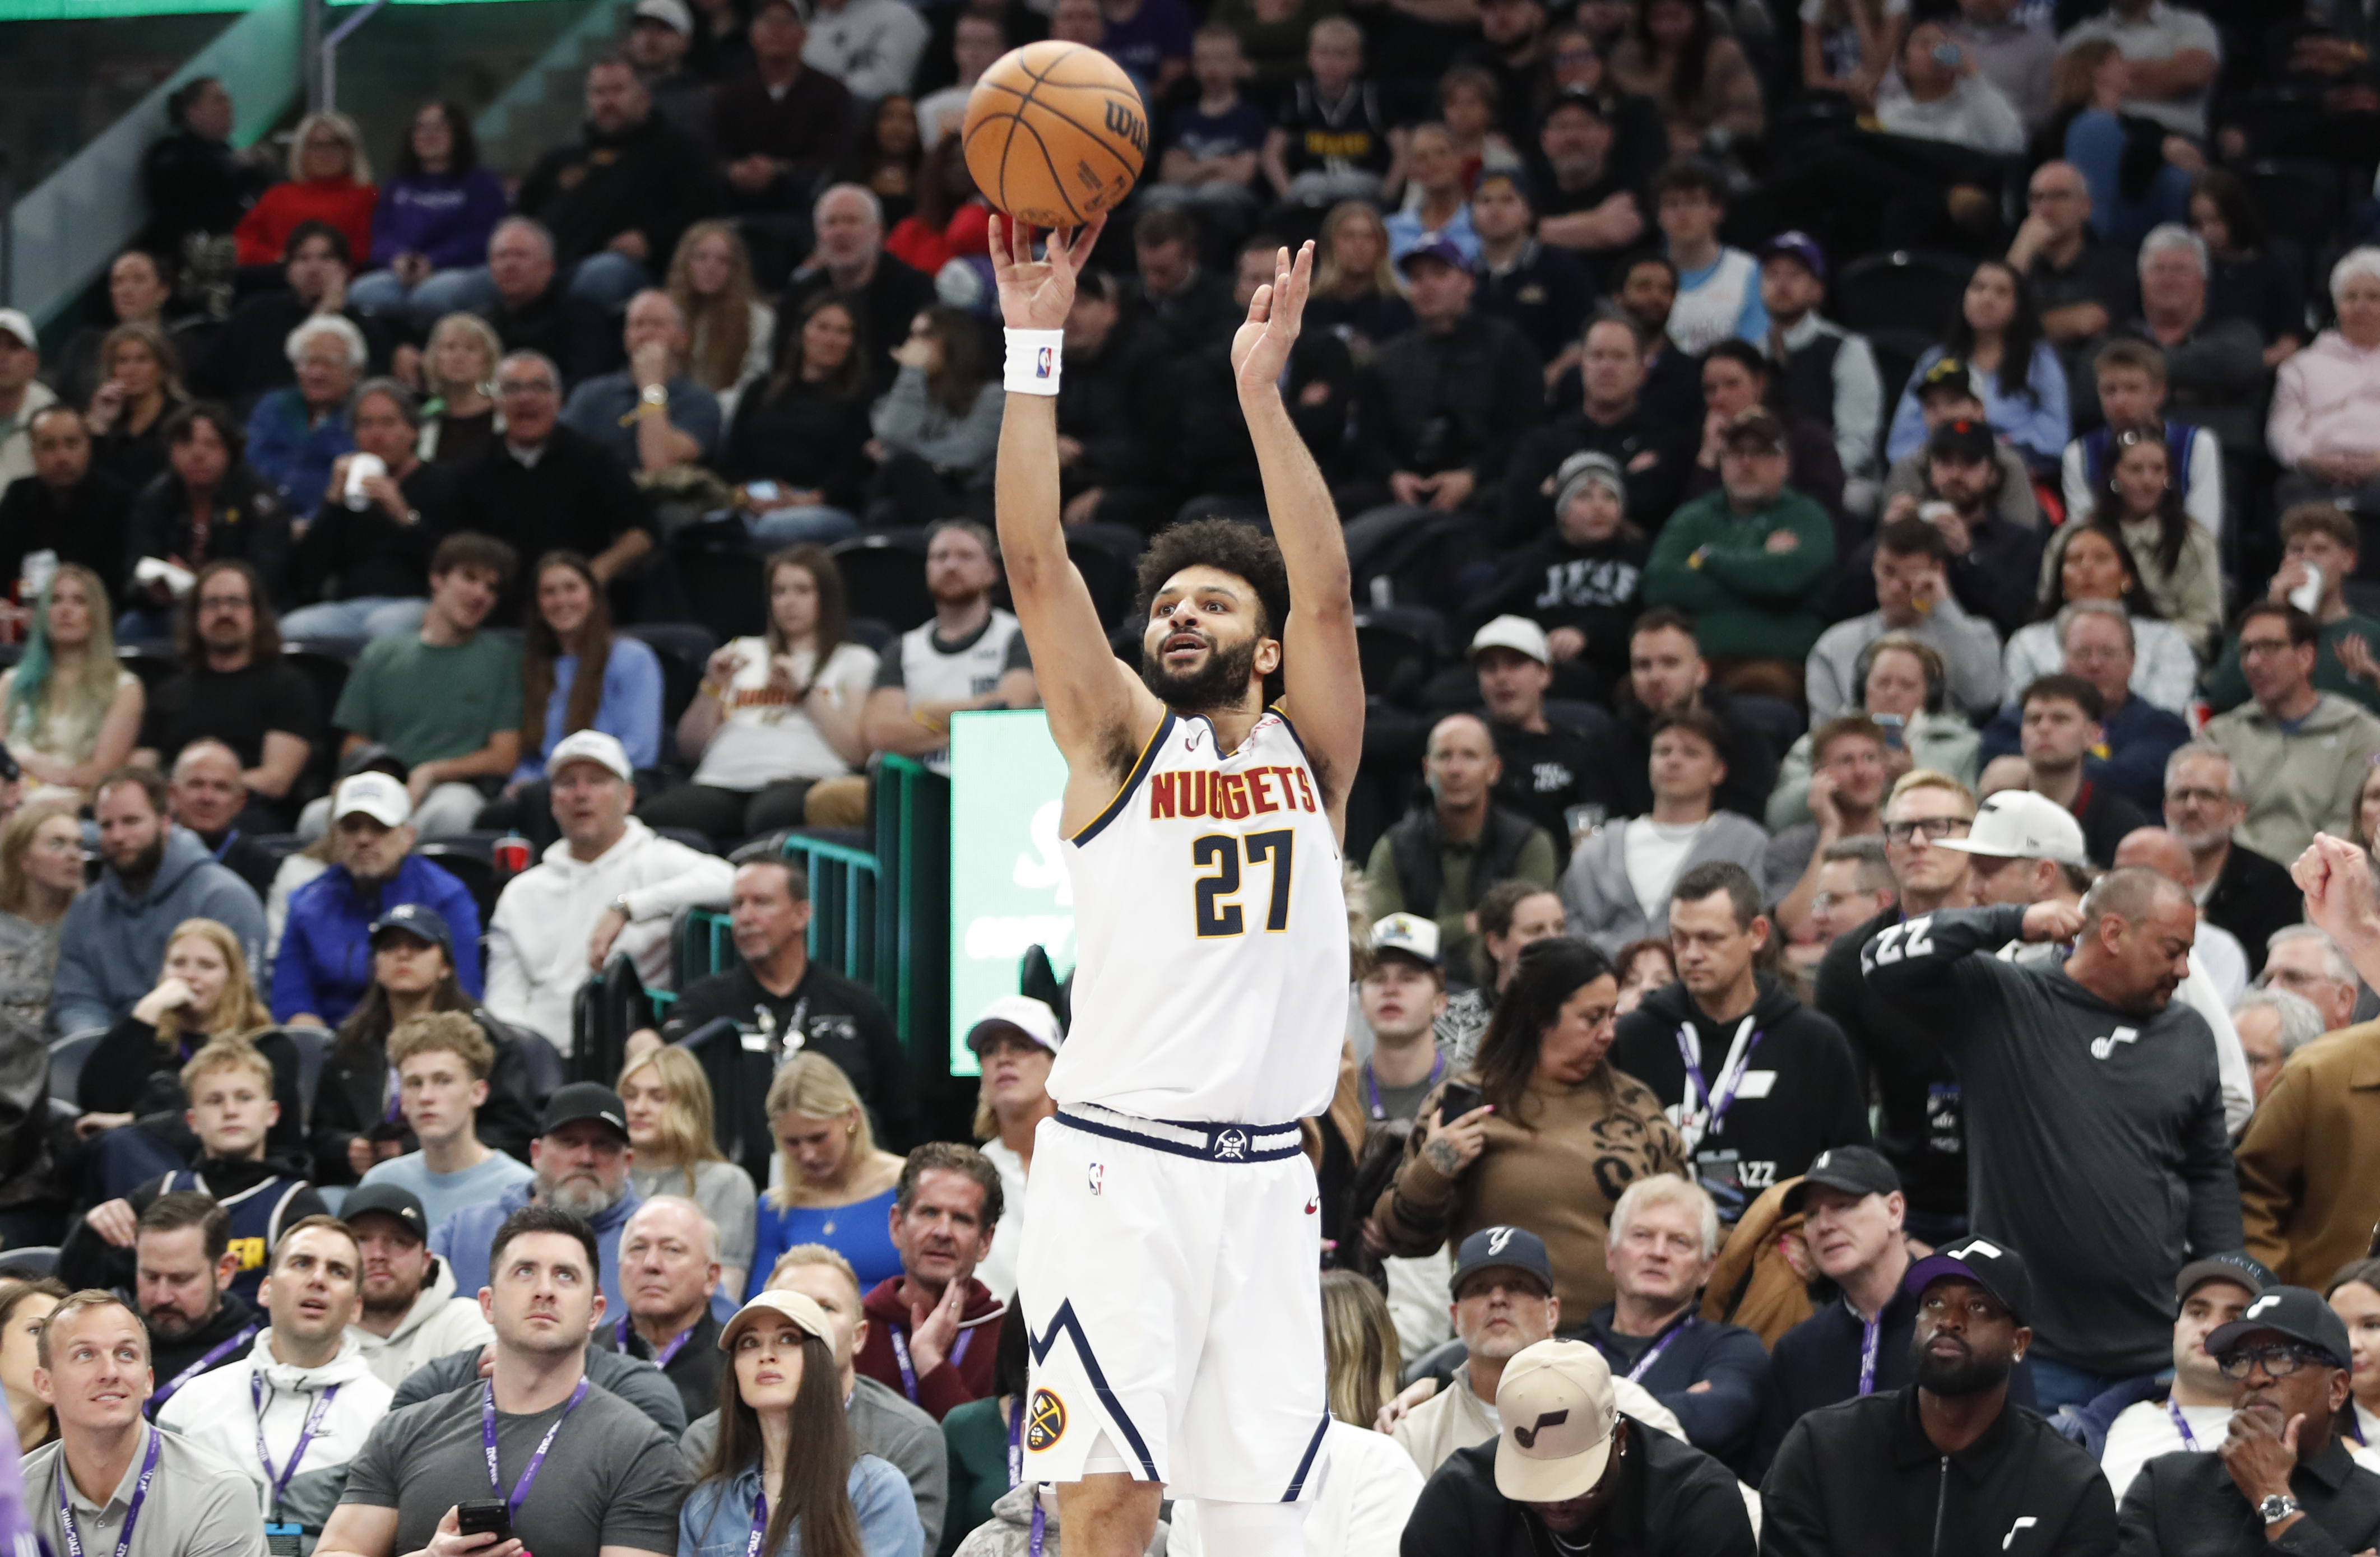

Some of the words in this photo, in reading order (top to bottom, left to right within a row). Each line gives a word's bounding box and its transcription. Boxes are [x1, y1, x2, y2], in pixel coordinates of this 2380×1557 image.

[1150, 766, 1317, 821] NUGGETS
[1191, 827, 1295, 940] 27
[61, 1507, 74, 1529] UTAH
[67, 1536, 81, 1557] JAZZ
[115, 1542, 129, 1557] AZZ
[747, 1530, 762, 1554] JAZZ
